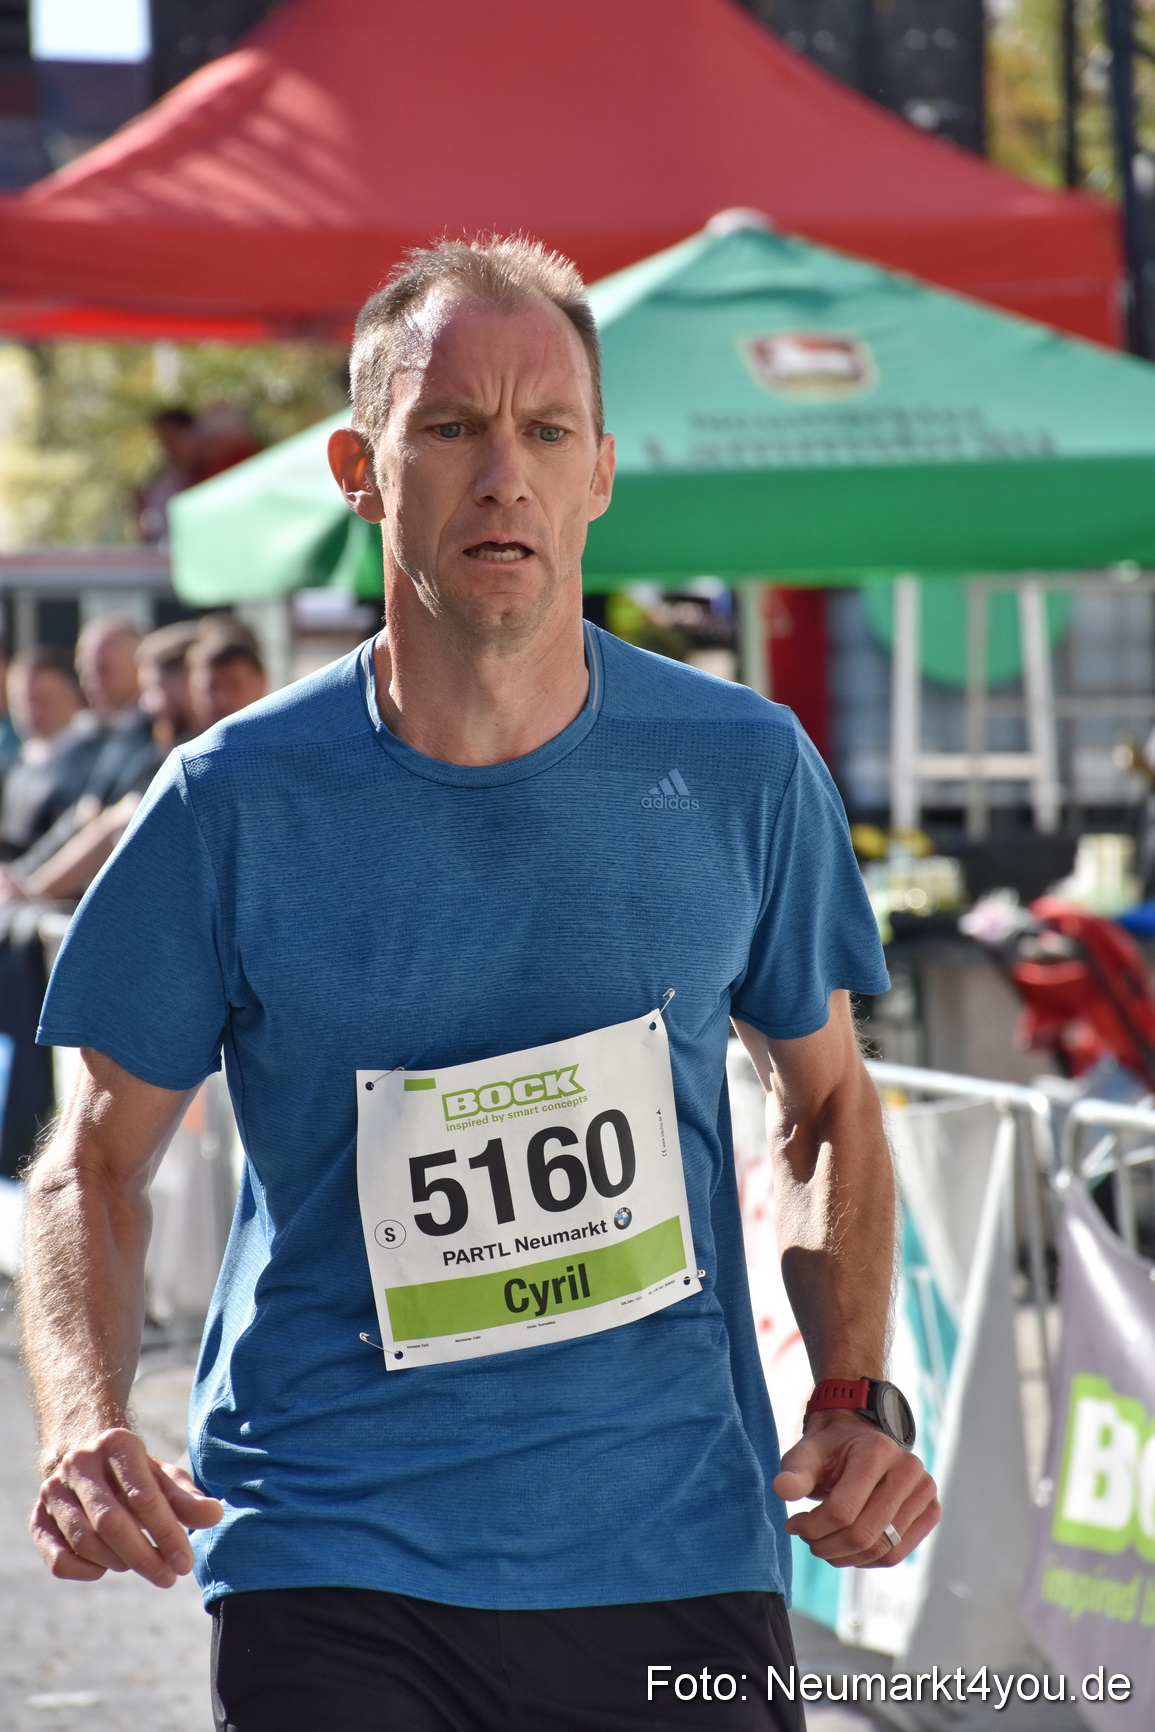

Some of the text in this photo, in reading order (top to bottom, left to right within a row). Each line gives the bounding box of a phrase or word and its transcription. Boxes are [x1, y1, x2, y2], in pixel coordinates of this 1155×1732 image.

[641, 794, 700, 811] adidas
[443, 1064, 585, 1121] BOCK
[446, 1094, 588, 1132] inspired by smart concepts
[408, 1108, 637, 1237] 5160
[384, 1227, 396, 1242] S
[442, 1219, 608, 1266] PARTL Neumarkt
[503, 1263, 591, 1317] Cyril
